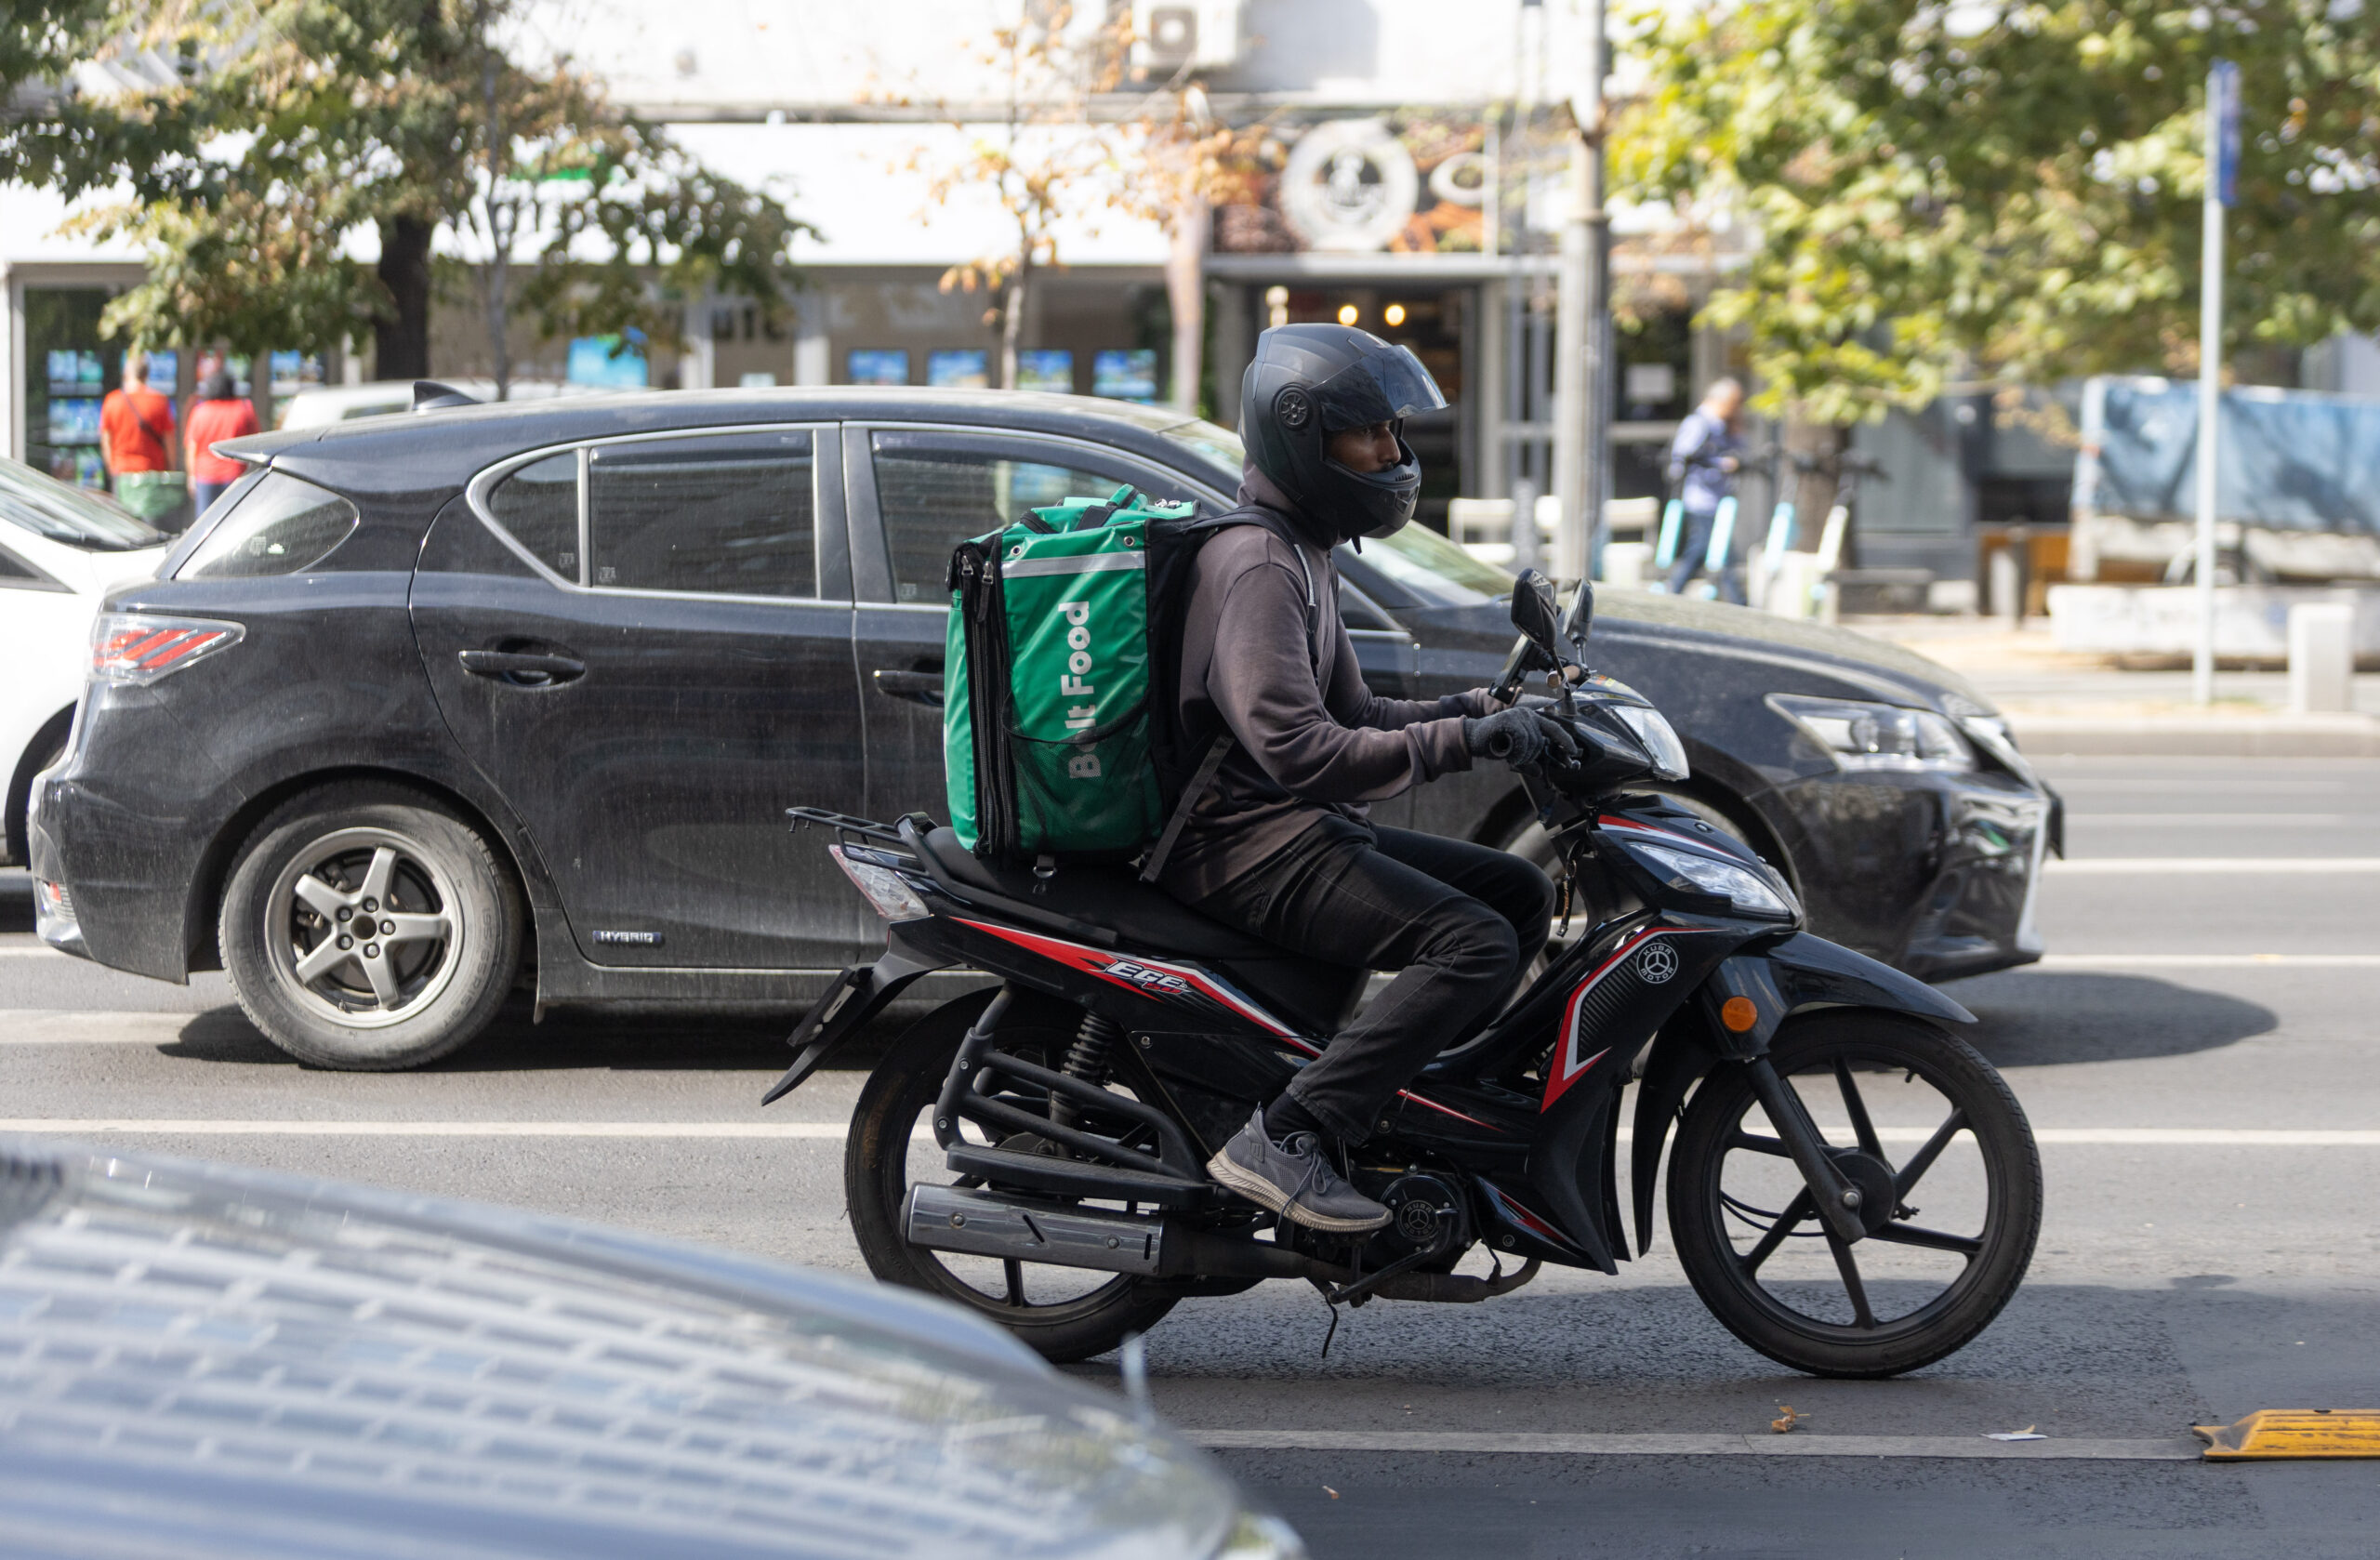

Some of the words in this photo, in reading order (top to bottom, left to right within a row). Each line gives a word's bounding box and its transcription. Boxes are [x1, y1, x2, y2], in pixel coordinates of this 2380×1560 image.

[1058, 601, 1094, 696] Food
[601, 931, 654, 943] HYBRID
[1643, 945, 1672, 956] KUBA
[1106, 961, 1185, 987] EGE
[1641, 967, 1673, 981] MOTOR
